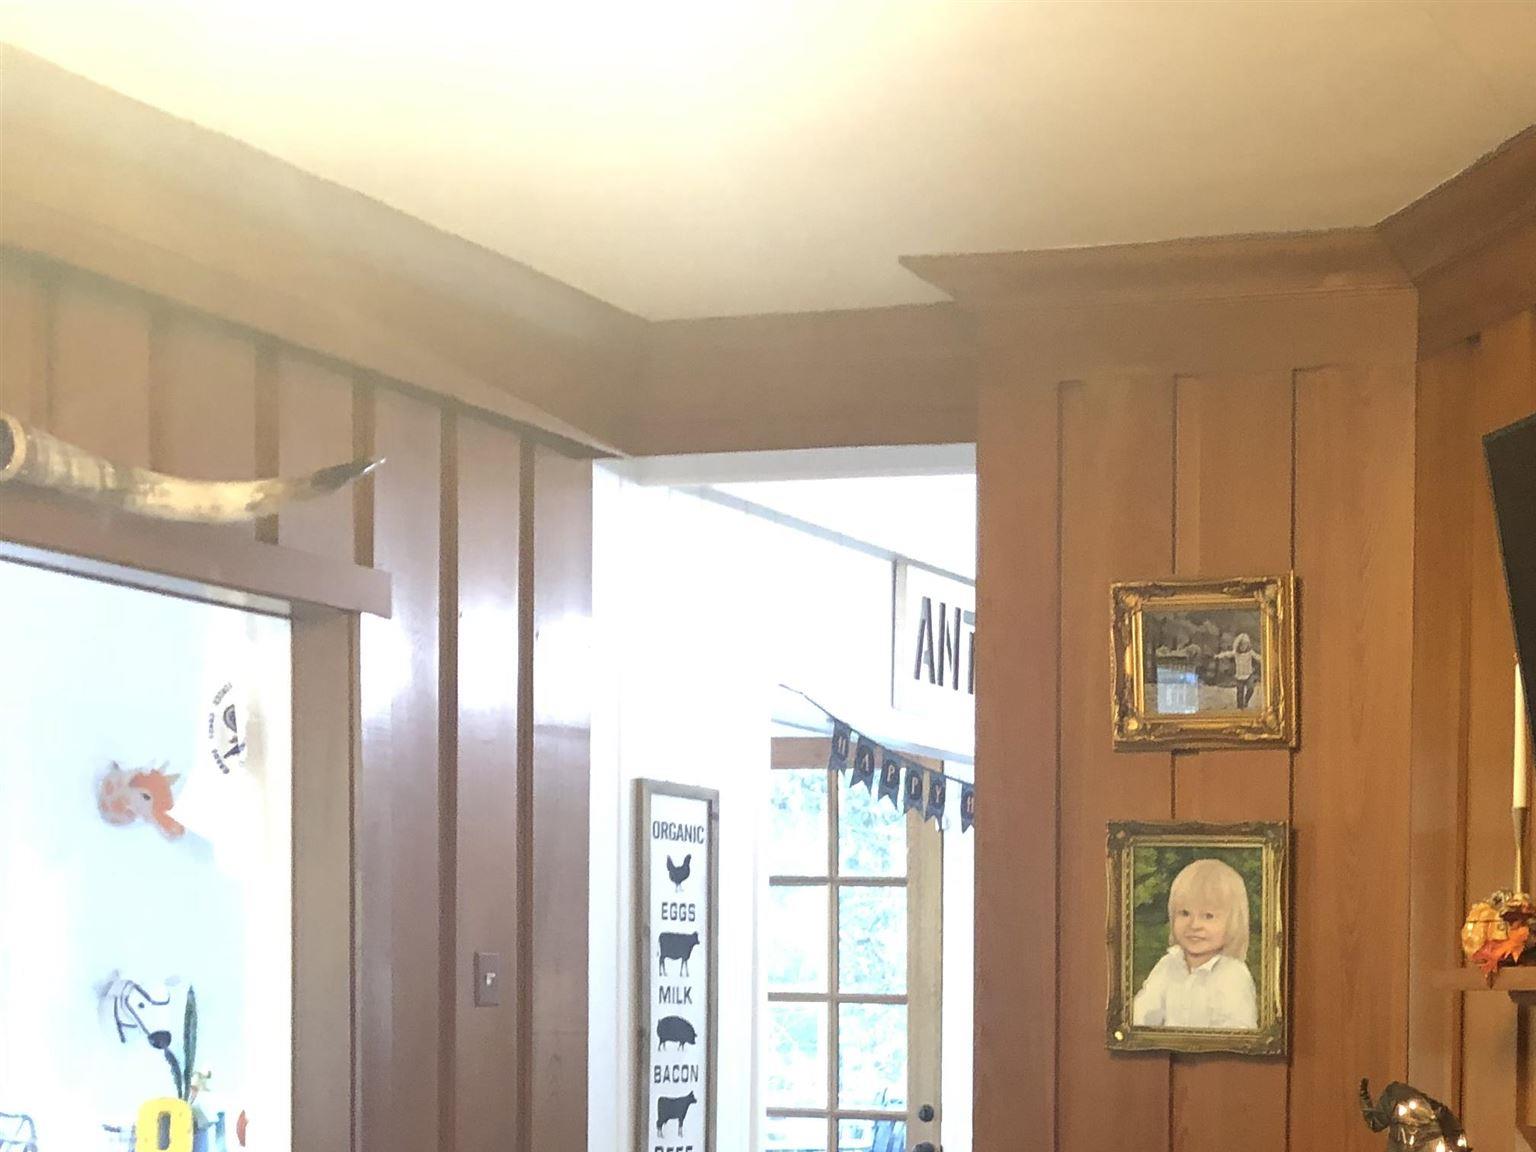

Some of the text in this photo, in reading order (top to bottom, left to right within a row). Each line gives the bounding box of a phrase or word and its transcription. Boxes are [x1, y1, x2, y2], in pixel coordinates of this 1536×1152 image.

[652, 820, 705, 845] ORGANIC
[661, 901, 697, 923] EGGS
[658, 985, 693, 1005] MILK
[653, 1064, 699, 1084] BACON
